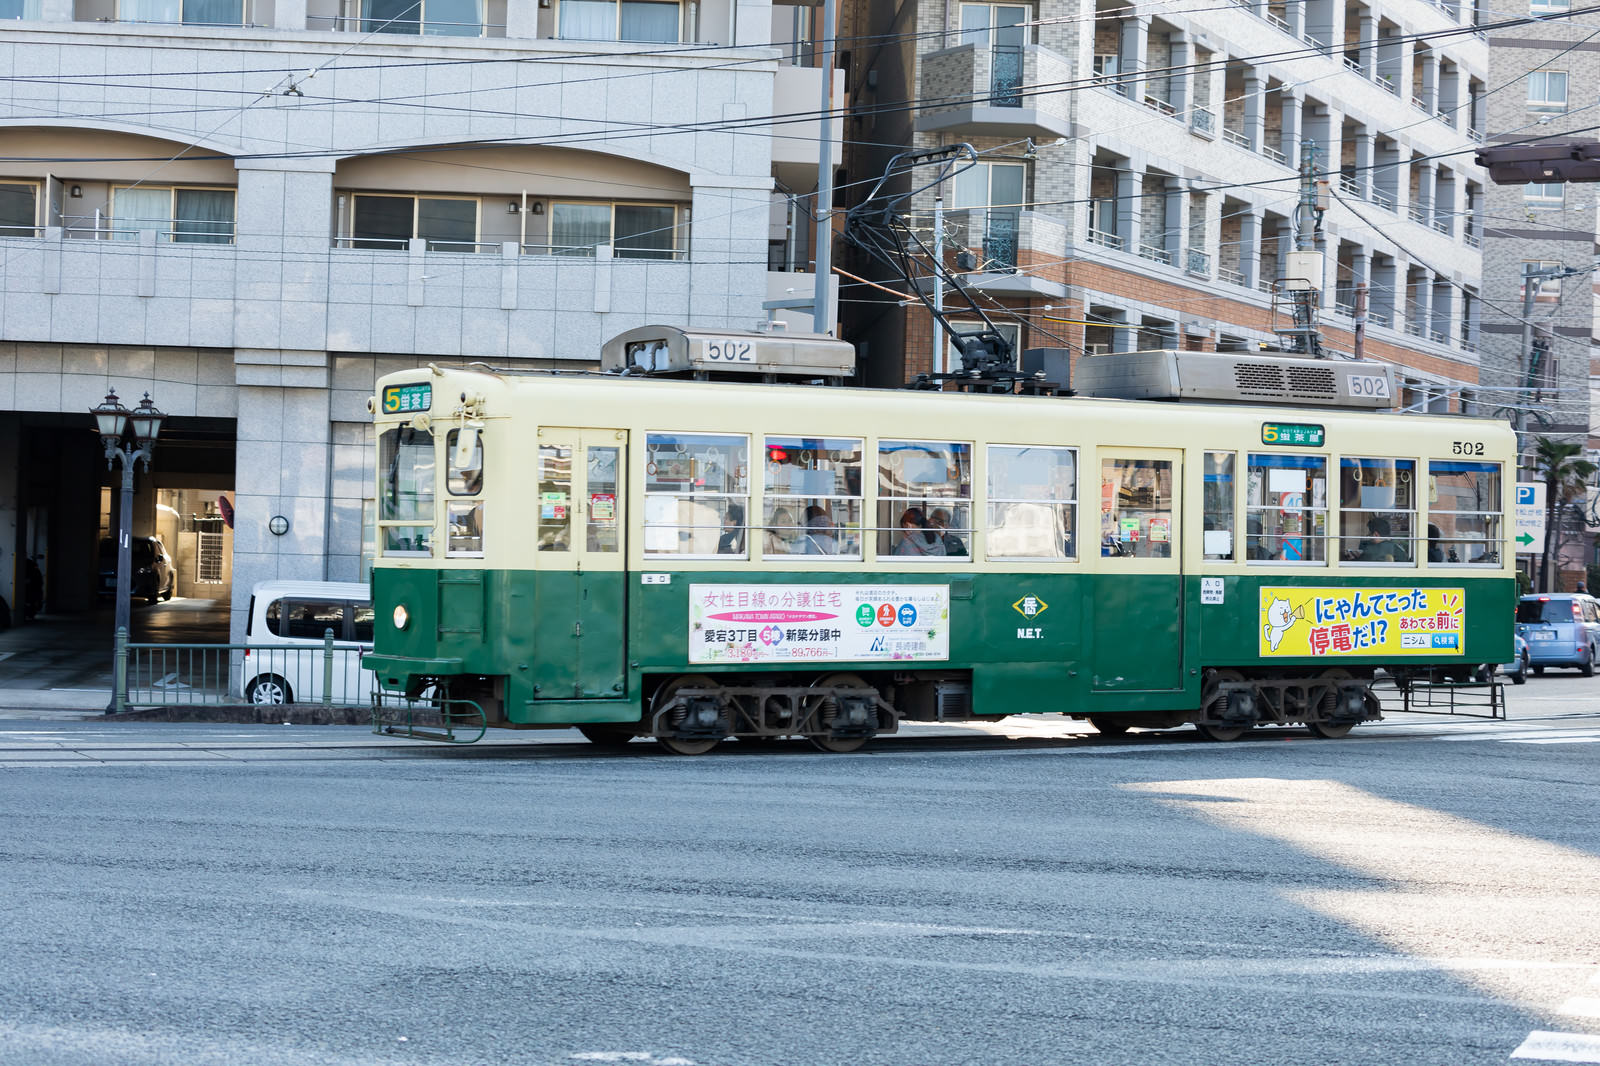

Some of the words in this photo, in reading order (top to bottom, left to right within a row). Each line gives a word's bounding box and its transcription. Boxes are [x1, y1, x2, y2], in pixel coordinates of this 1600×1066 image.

[709, 341, 751, 361] 502
[1352, 376, 1386, 396] 502
[385, 387, 400, 412] 5
[1263, 426, 1278, 442] 5
[1452, 441, 1485, 456] 502
[1517, 487, 1531, 504] P
[703, 590, 841, 609] 女性目線の分譲住宅
[1315, 589, 1427, 623] にゃんてこった
[1400, 611, 1460, 630] あわてる前に
[704, 629, 757, 643] 愛宕3丁目
[786, 628, 841, 641] 新築分譲中
[1017, 628, 1044, 639] N.E.T.
[1403, 636, 1425, 645] ニシム
